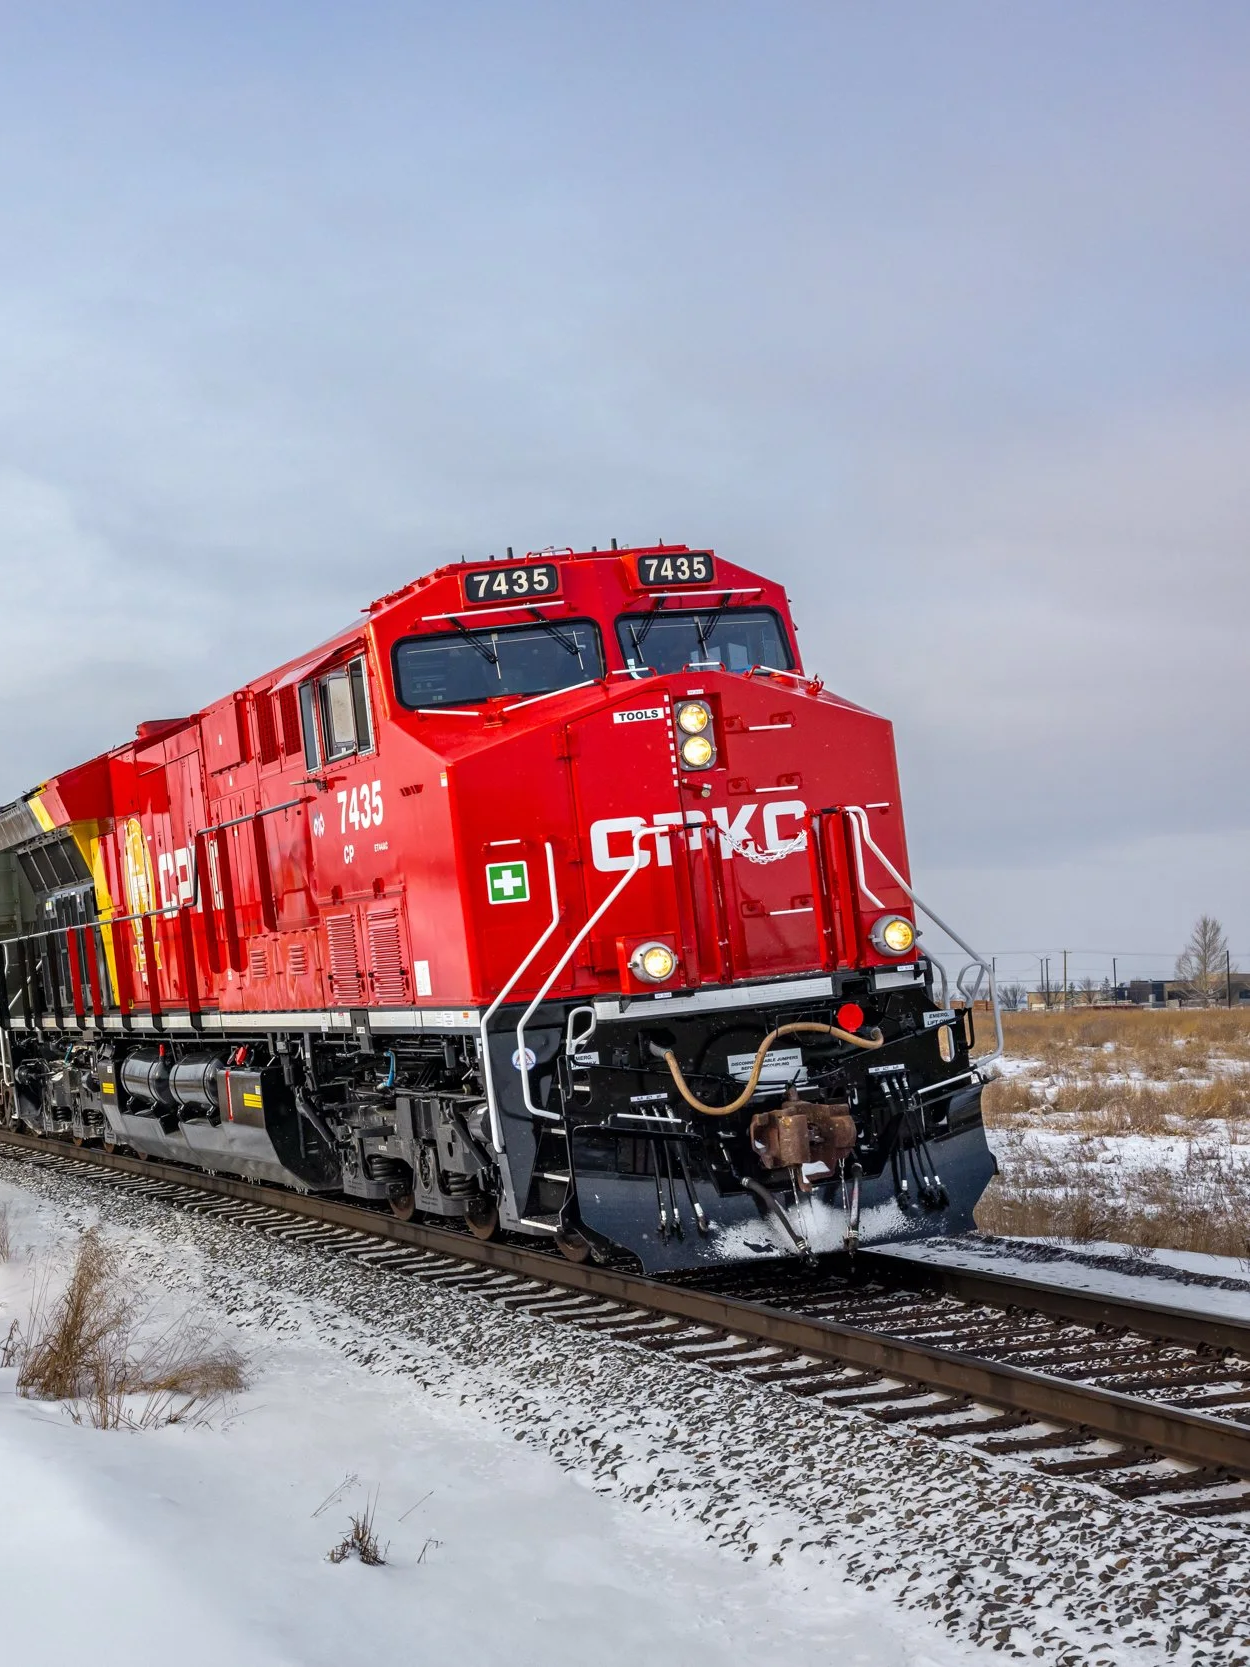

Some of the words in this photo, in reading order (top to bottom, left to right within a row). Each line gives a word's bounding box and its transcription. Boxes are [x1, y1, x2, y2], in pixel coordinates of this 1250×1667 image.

[473, 567, 549, 598] 7435
[644, 556, 707, 582] 7435
[619, 709, 659, 722] TOOLS
[336, 779, 384, 834] 7435
[589, 799, 808, 872] CPKC
[343, 844, 355, 865] CP
